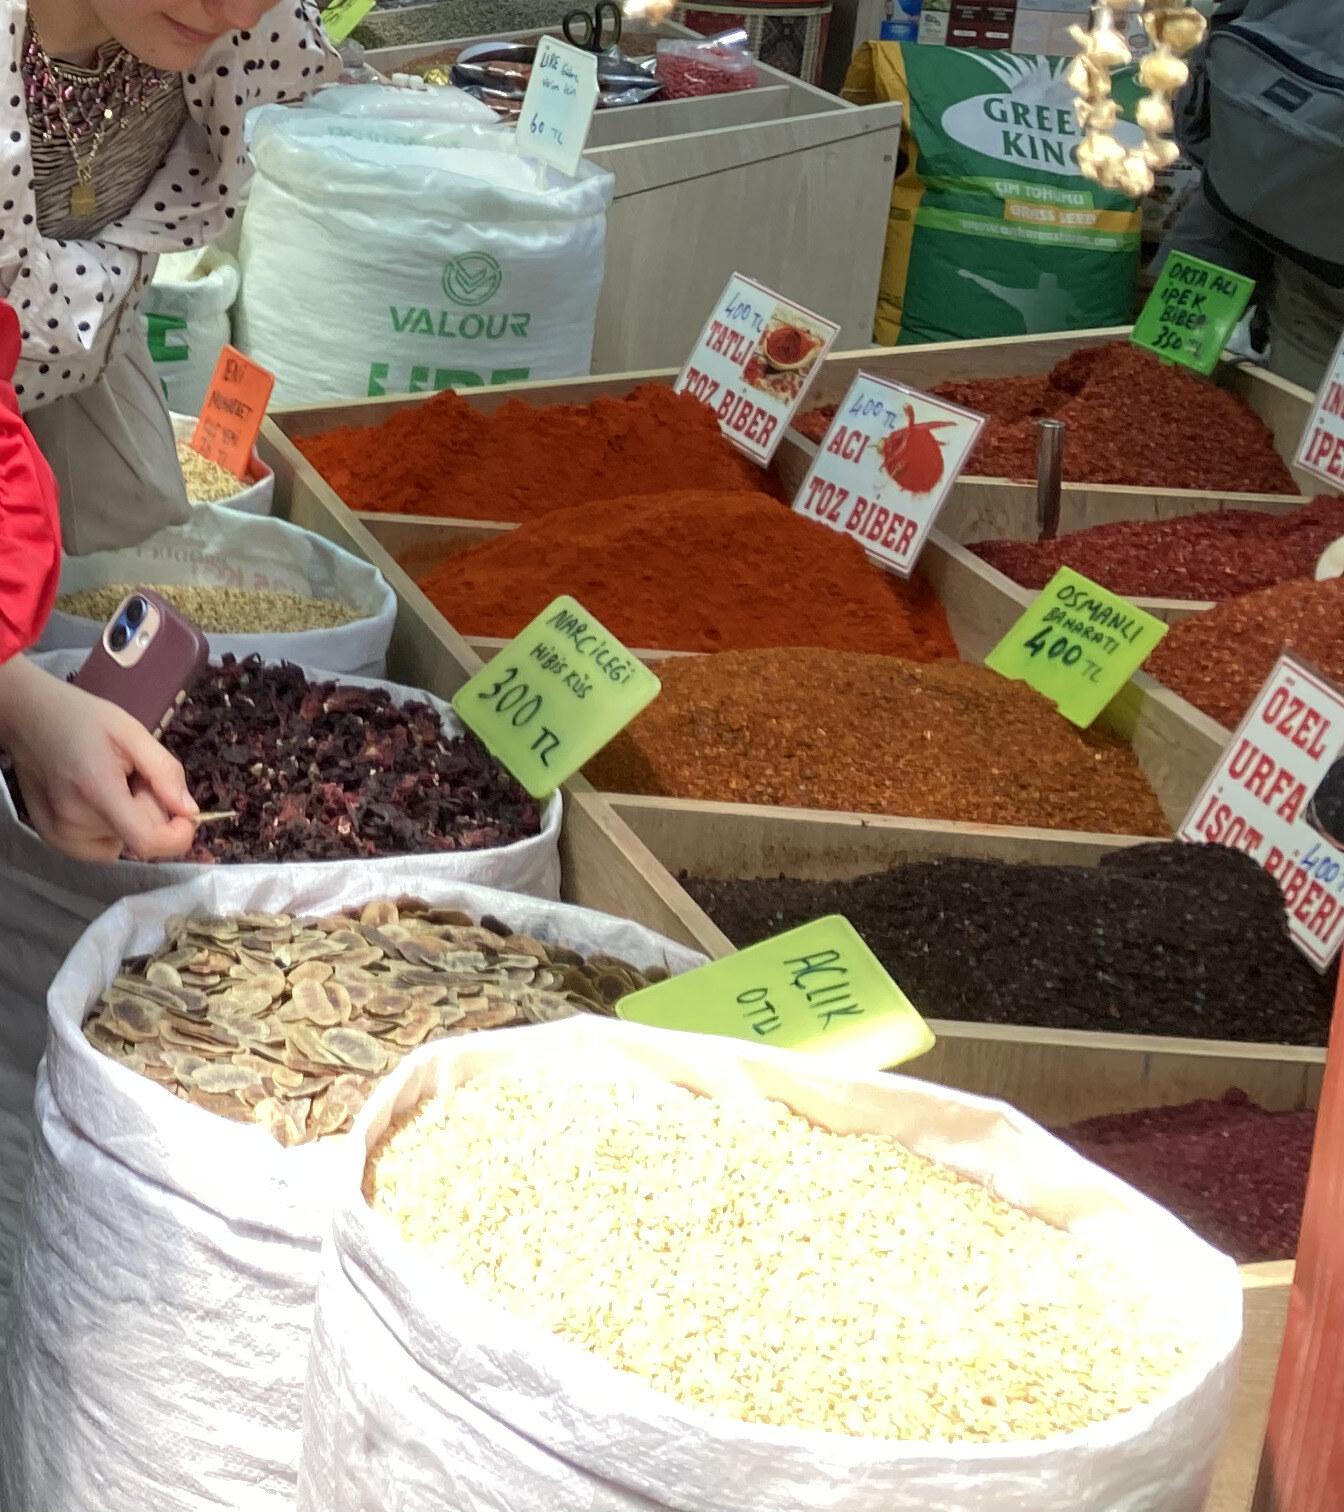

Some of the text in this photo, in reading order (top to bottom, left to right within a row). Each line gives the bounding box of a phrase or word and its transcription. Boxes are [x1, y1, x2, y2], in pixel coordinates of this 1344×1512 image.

[530, 112, 563, 145] 60 TL
[983, 97, 1086, 136] GREE
[388, 305, 531, 339] VALOUR
[725, 292, 751, 320] 400
[705, 320, 755, 367] TATLI
[686, 366, 720, 406] TOZ
[849, 393, 898, 429] 400 TL
[826, 424, 871, 464] ACI
[1305, 417, 1344, 480] İPE
[804, 475, 919, 557] TOZ BİBER
[1056, 584, 1144, 644] OSMANLI
[1023, 625, 1103, 683] 400 TL
[477, 666, 561, 768] 300 TL
[1262, 676, 1332, 762] ÖZEL
[1228, 738, 1309, 825] URFA
[736, 987, 782, 1035] OTU
